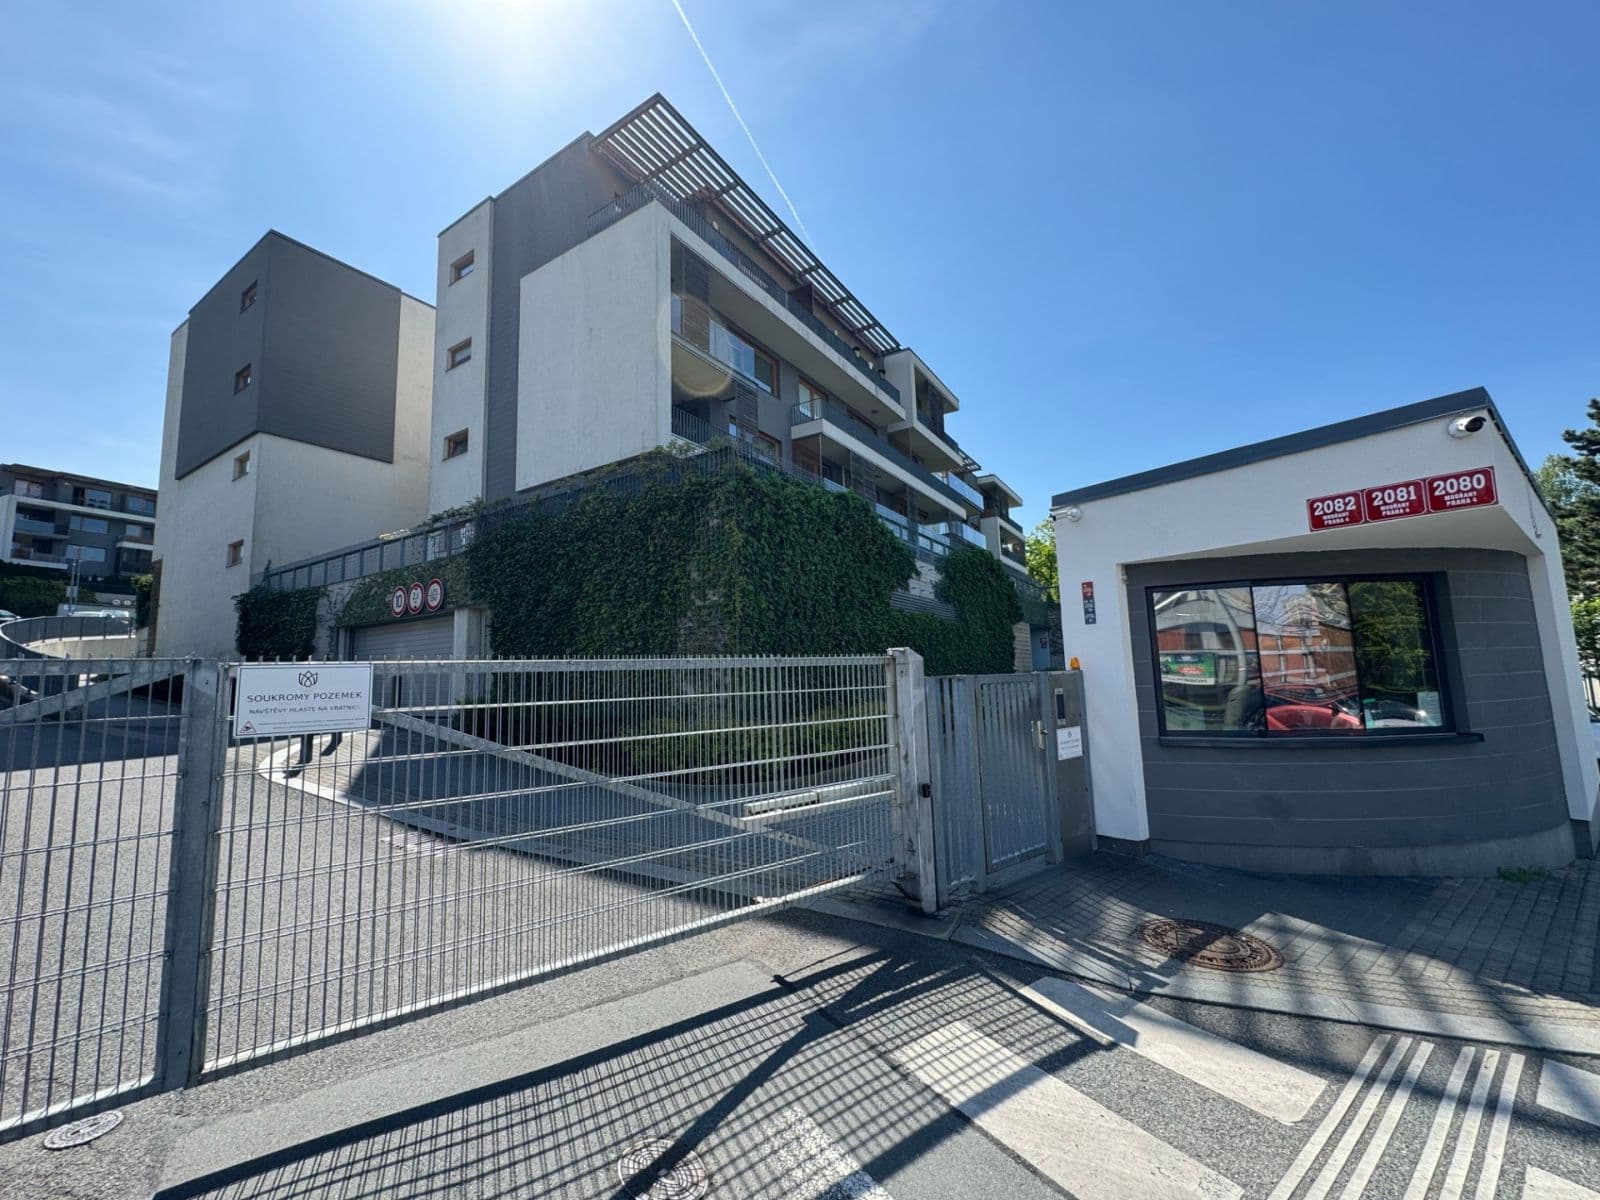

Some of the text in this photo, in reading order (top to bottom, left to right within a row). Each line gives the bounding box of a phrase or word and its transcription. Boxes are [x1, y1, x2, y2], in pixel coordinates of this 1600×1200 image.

[1432, 473, 1486, 496] 2080
[1371, 485, 1417, 506] 2081
[1313, 496, 1357, 516] 2082
[1446, 498, 1471, 507] PRAHA
[1382, 508, 1404, 517] PRAHA
[1324, 517, 1345, 526] PRAHA
[395, 594, 403, 609] 10
[313, 691, 363, 700] POZEMEK
